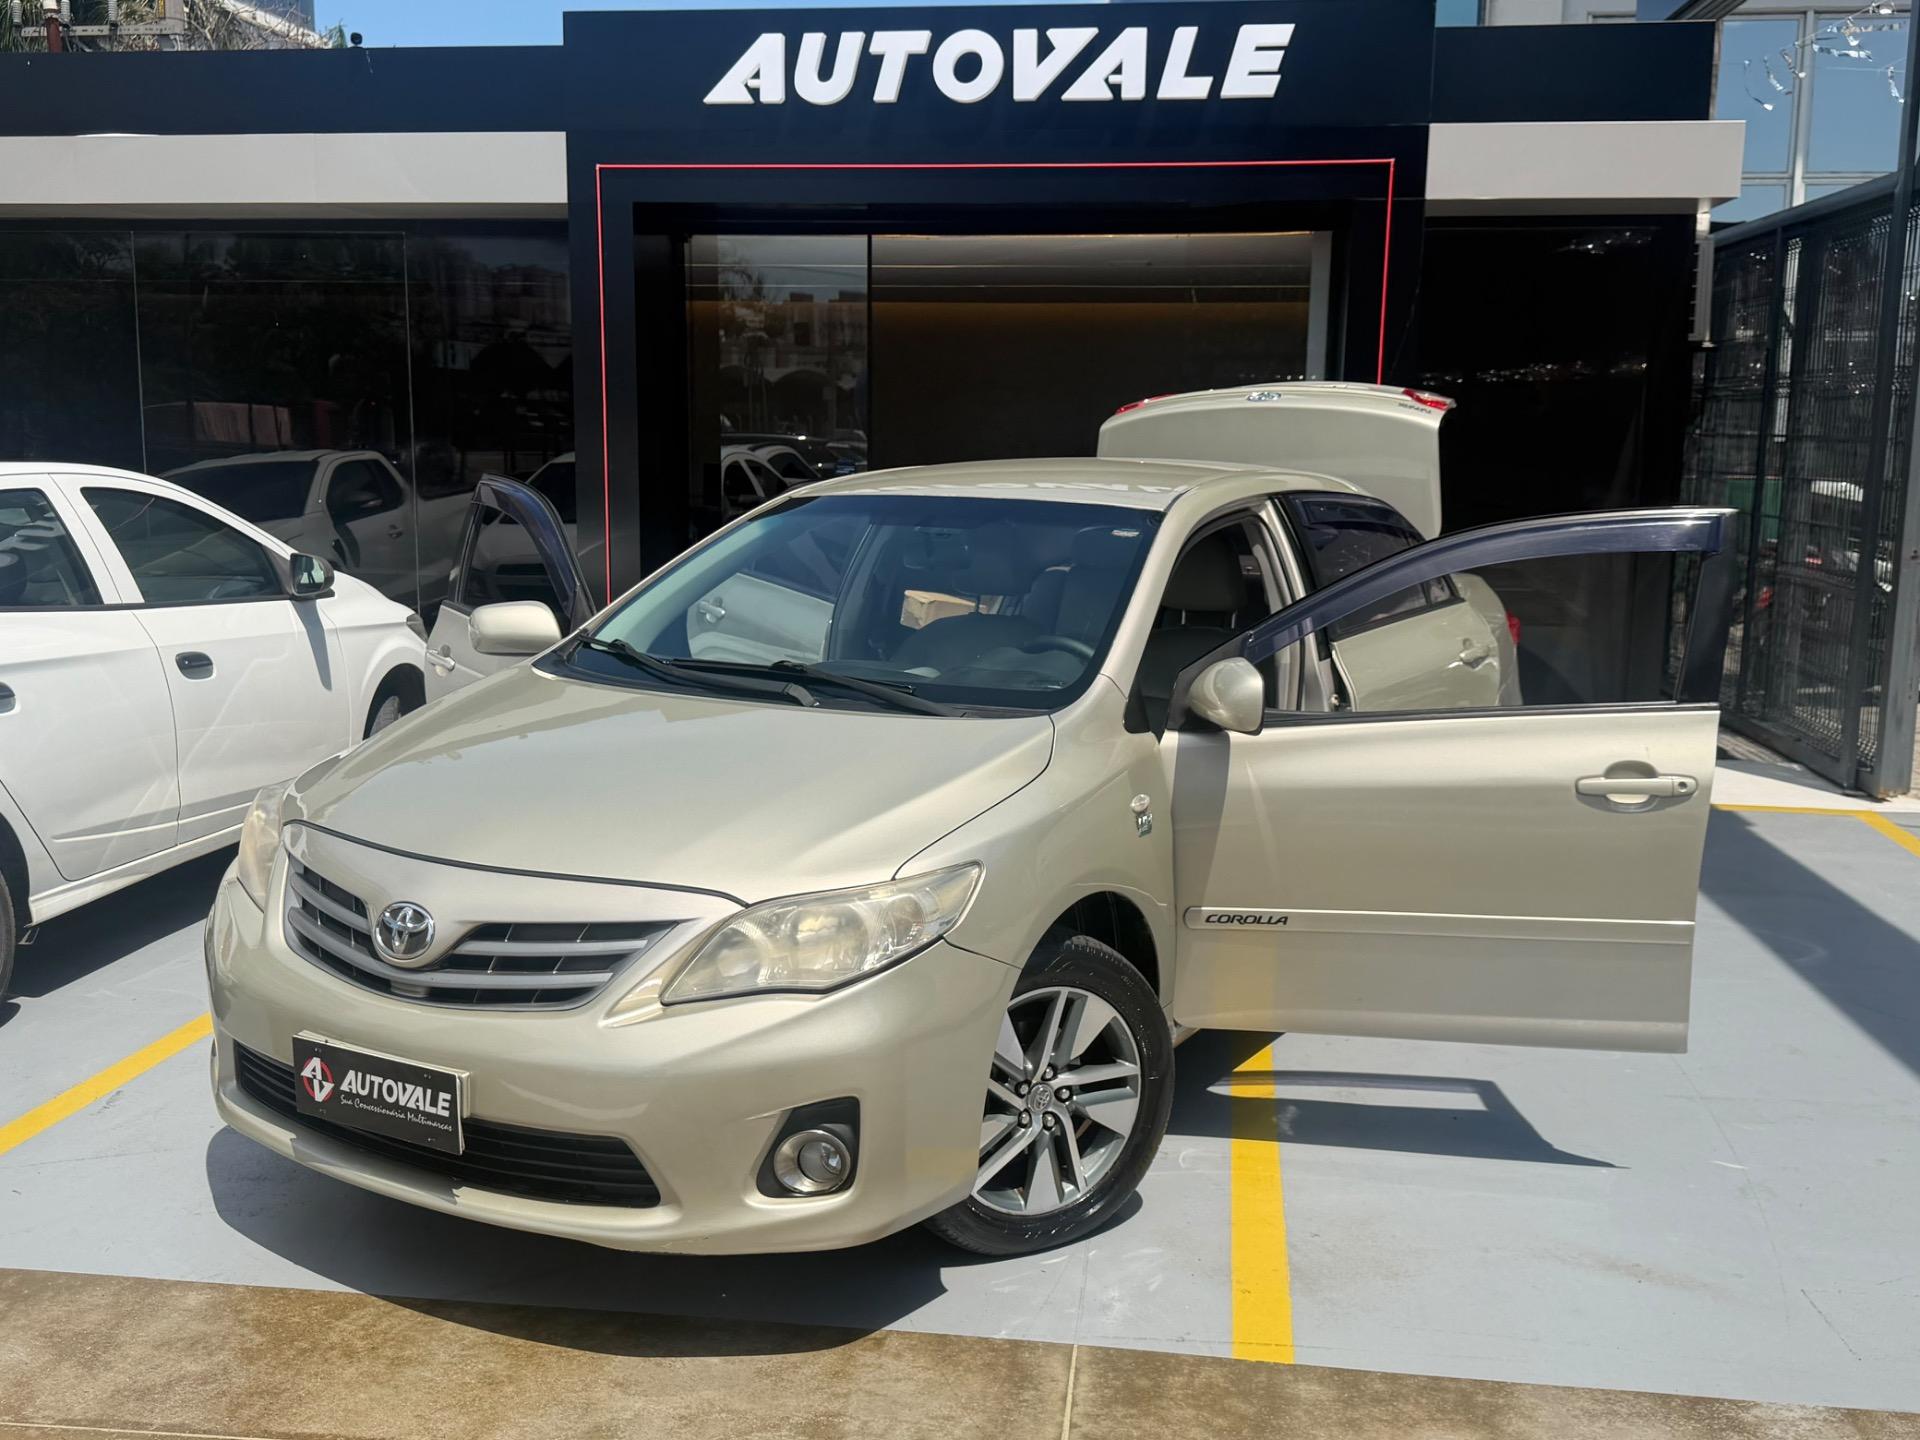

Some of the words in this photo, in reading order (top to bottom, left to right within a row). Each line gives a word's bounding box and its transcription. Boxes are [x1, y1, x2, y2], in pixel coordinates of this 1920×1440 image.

[703, 23, 1295, 104] AUTOVALE
[1205, 914, 1288, 925] COROLLA
[340, 1070, 452, 1117] AUTOVALE
